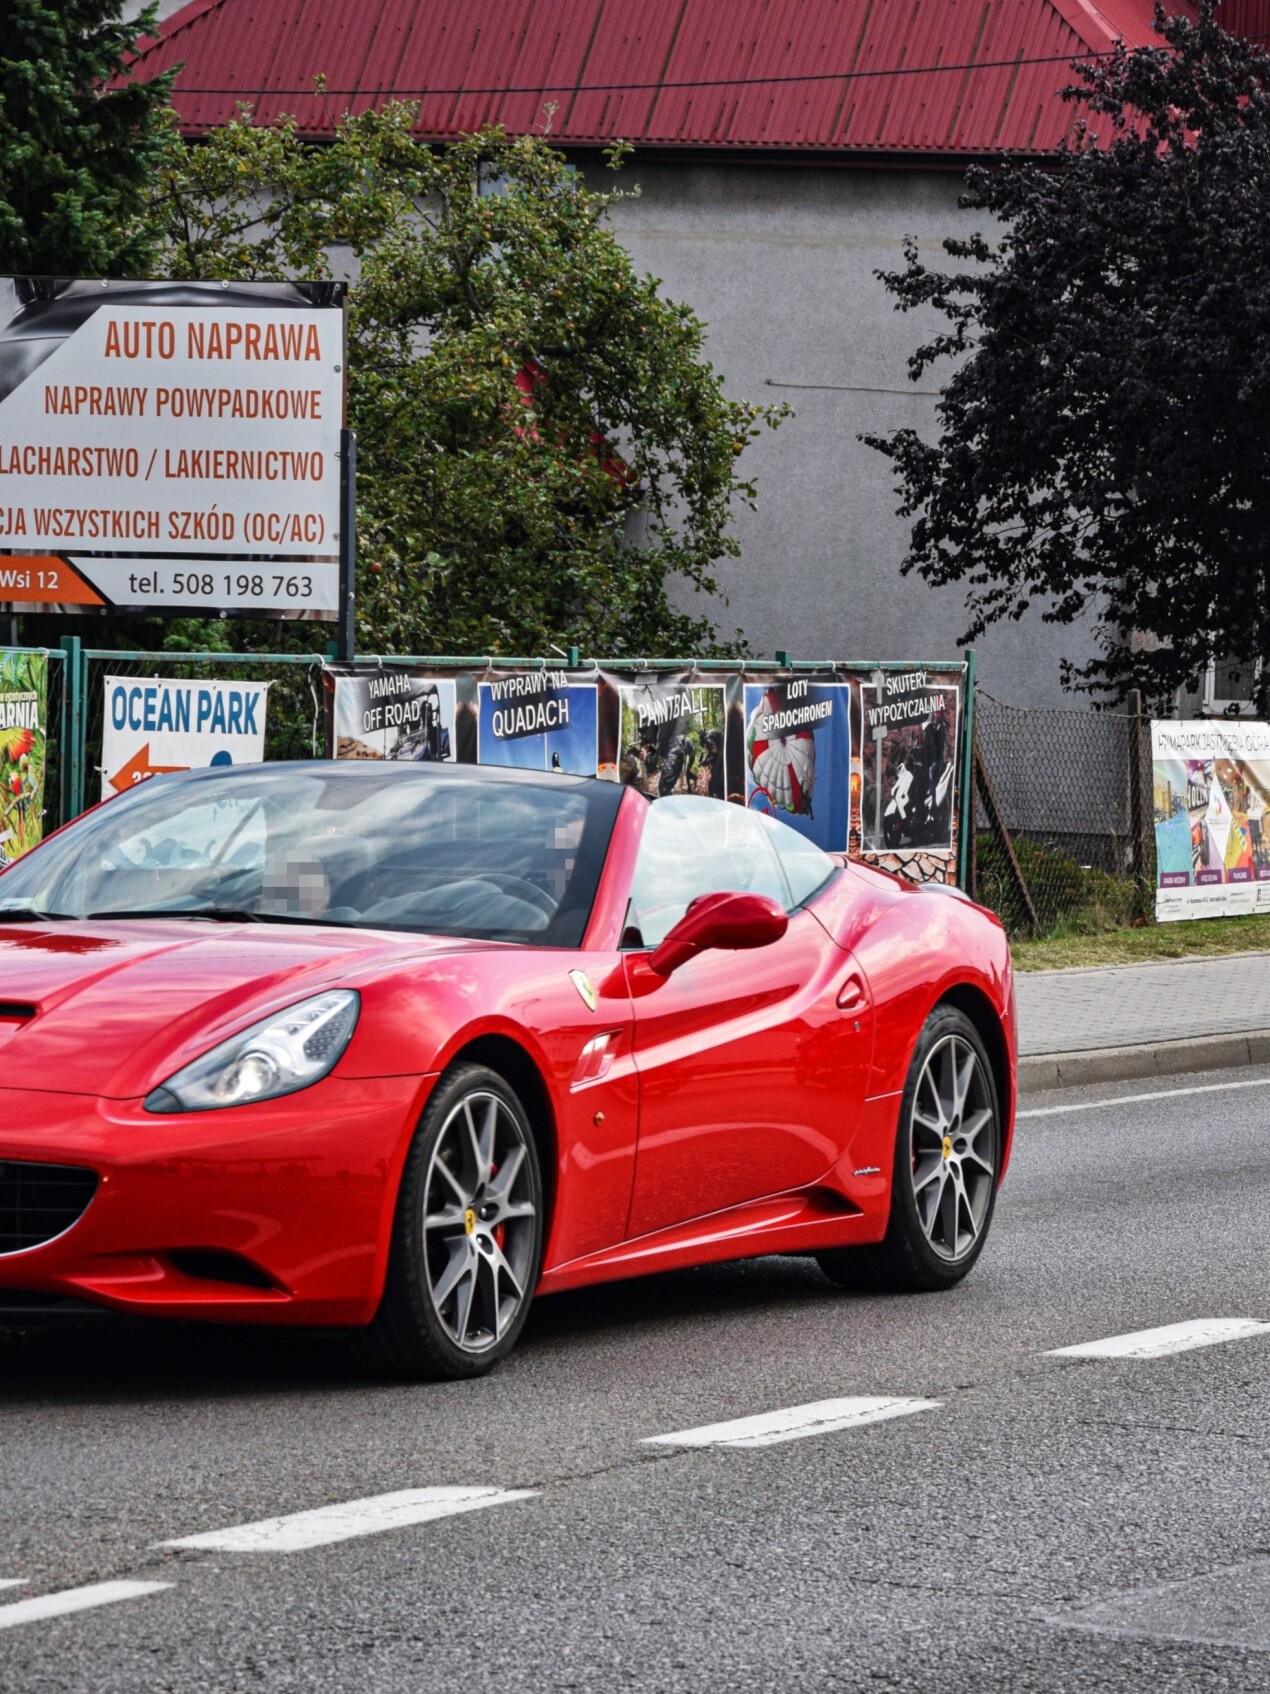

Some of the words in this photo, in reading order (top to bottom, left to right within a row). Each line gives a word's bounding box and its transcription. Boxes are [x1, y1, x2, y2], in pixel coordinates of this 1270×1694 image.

[104, 321, 175, 360] AUTO
[187, 322, 321, 361] NAPRAWA
[45, 385, 148, 417] NAPRAWY
[156, 388, 322, 419] POWYPADKOWE
[165, 450, 324, 481] LAKIERNICTWO
[34, 509, 160, 539] WSZYSTKICH
[168, 504, 234, 540] SZKÓD
[243, 513, 325, 544] (OC/AC)
[0, 570, 30, 588] Wsi
[37, 571, 58, 589] 12
[129, 572, 164, 594] tel.
[172, 573, 214, 595] 508
[224, 575, 264, 597] 198
[272, 576, 313, 597] 763
[368, 674, 412, 700] YAMAHA
[490, 672, 550, 702] WYPRAWY
[551, 670, 569, 689] NA
[787, 679, 809, 701] LOTY
[886, 671, 927, 697] SKUTERY
[112, 686, 192, 732] OCEAN
[197, 689, 261, 735] PARK
[363, 707, 383, 733] OFF
[384, 700, 421, 728] ROAD
[492, 698, 570, 738] QUADACH
[638, 687, 709, 729] PAINTBALL
[762, 700, 833, 734] SPADOCHRONEM
[868, 693, 946, 726] WYPOŻYCZALNIA
